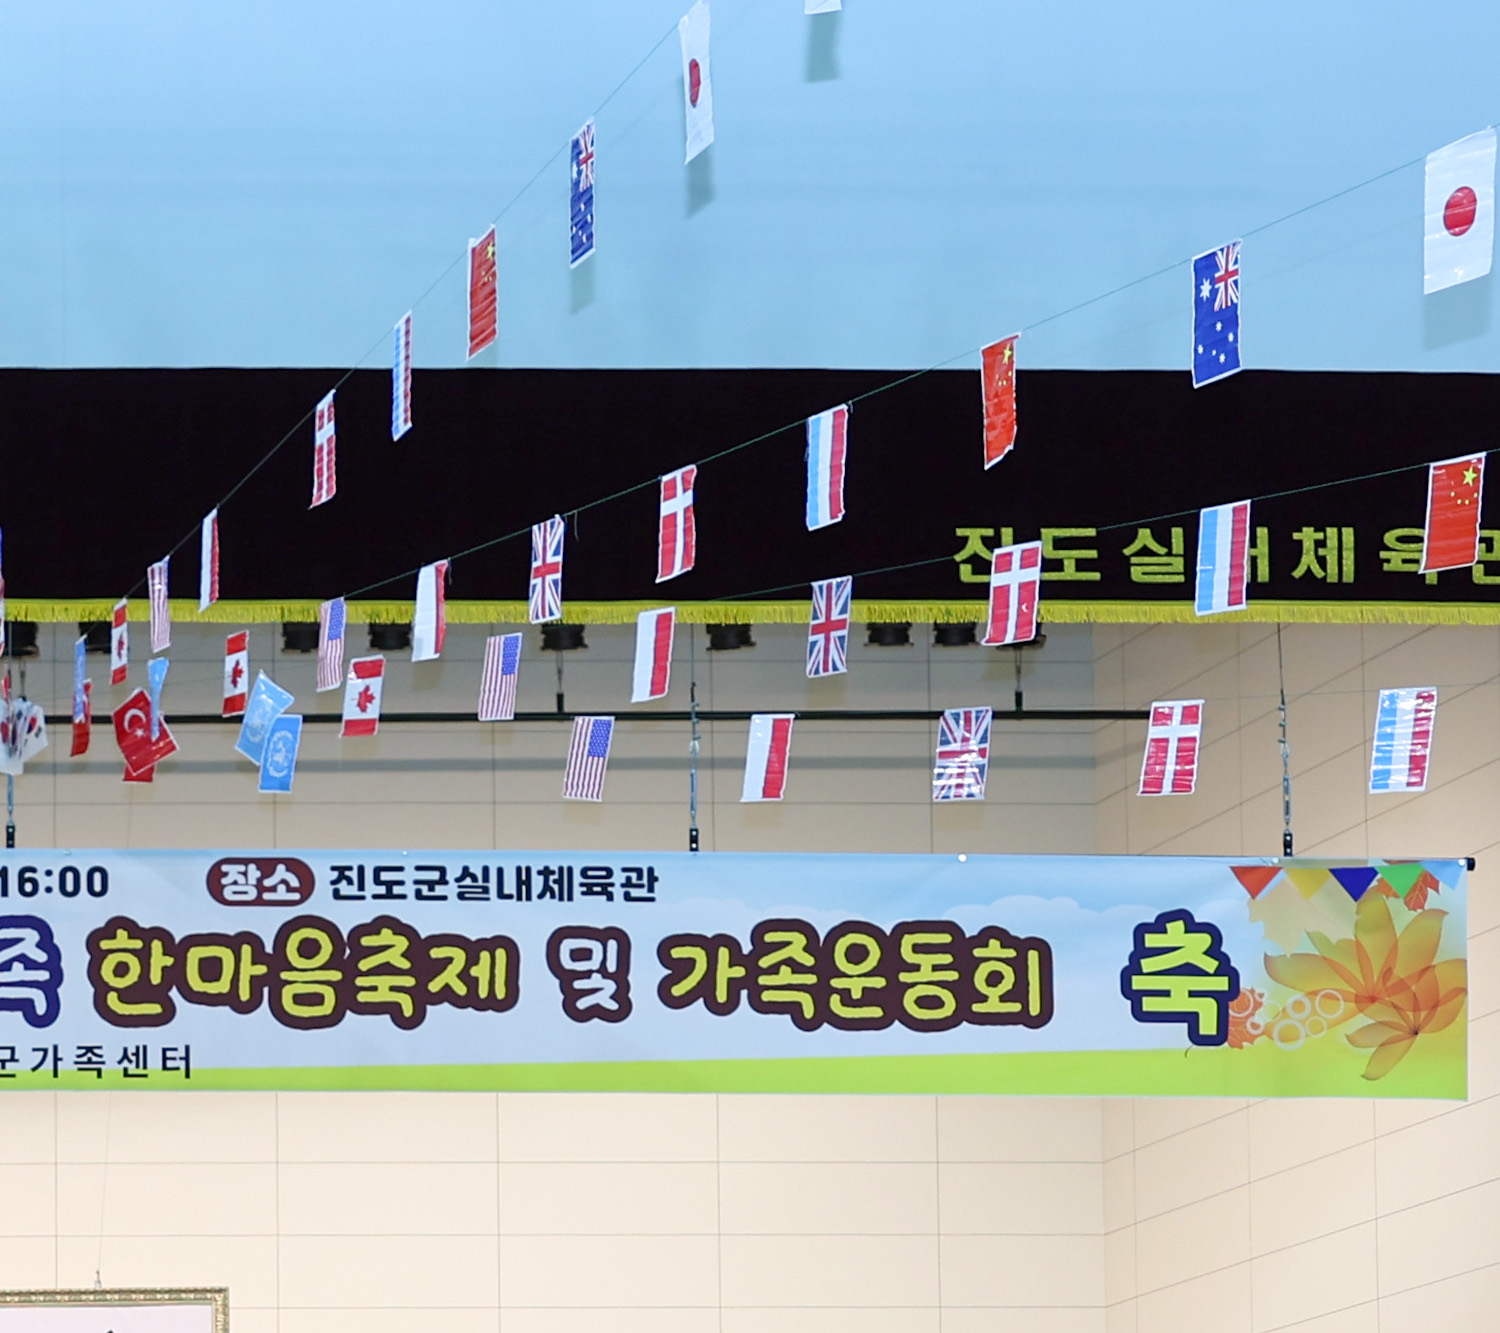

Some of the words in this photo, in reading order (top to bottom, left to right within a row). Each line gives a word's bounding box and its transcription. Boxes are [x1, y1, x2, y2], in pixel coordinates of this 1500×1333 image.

[217, 861, 305, 904] 장소
[328, 860, 660, 904] 진도군실내체육관
[88, 915, 518, 1030] 한마음축제
[546, 916, 632, 1022] 및
[656, 916, 1055, 1030] 가족운동회
[1123, 910, 1232, 1046] 축
